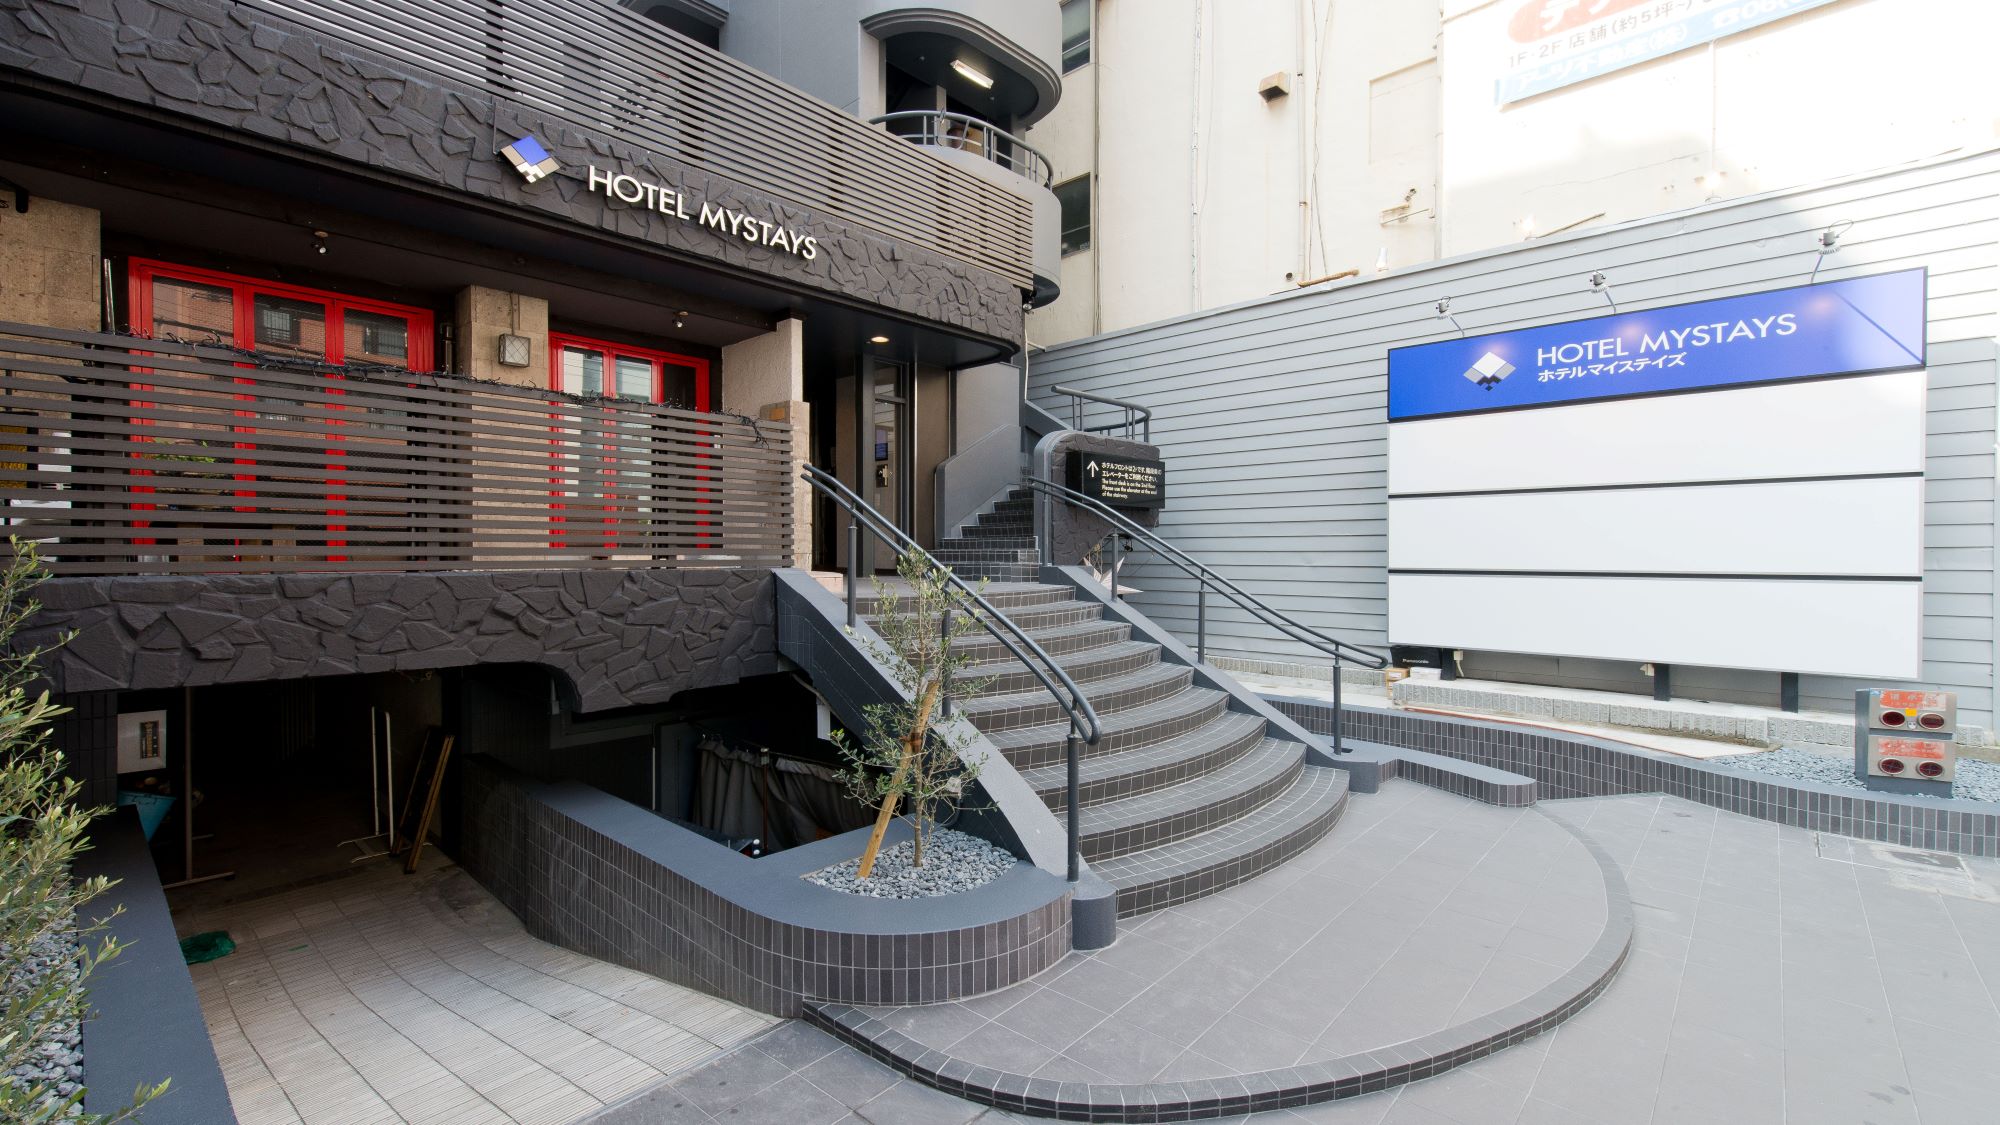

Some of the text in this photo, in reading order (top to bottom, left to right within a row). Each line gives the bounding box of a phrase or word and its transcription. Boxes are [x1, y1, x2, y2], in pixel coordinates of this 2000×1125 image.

[588, 164, 818, 260] HOTEL MYSTAYS
[1537, 313, 1798, 367] HOTEL MYSTAYS
[1537, 351, 1688, 383] ホテルマイステイズ
